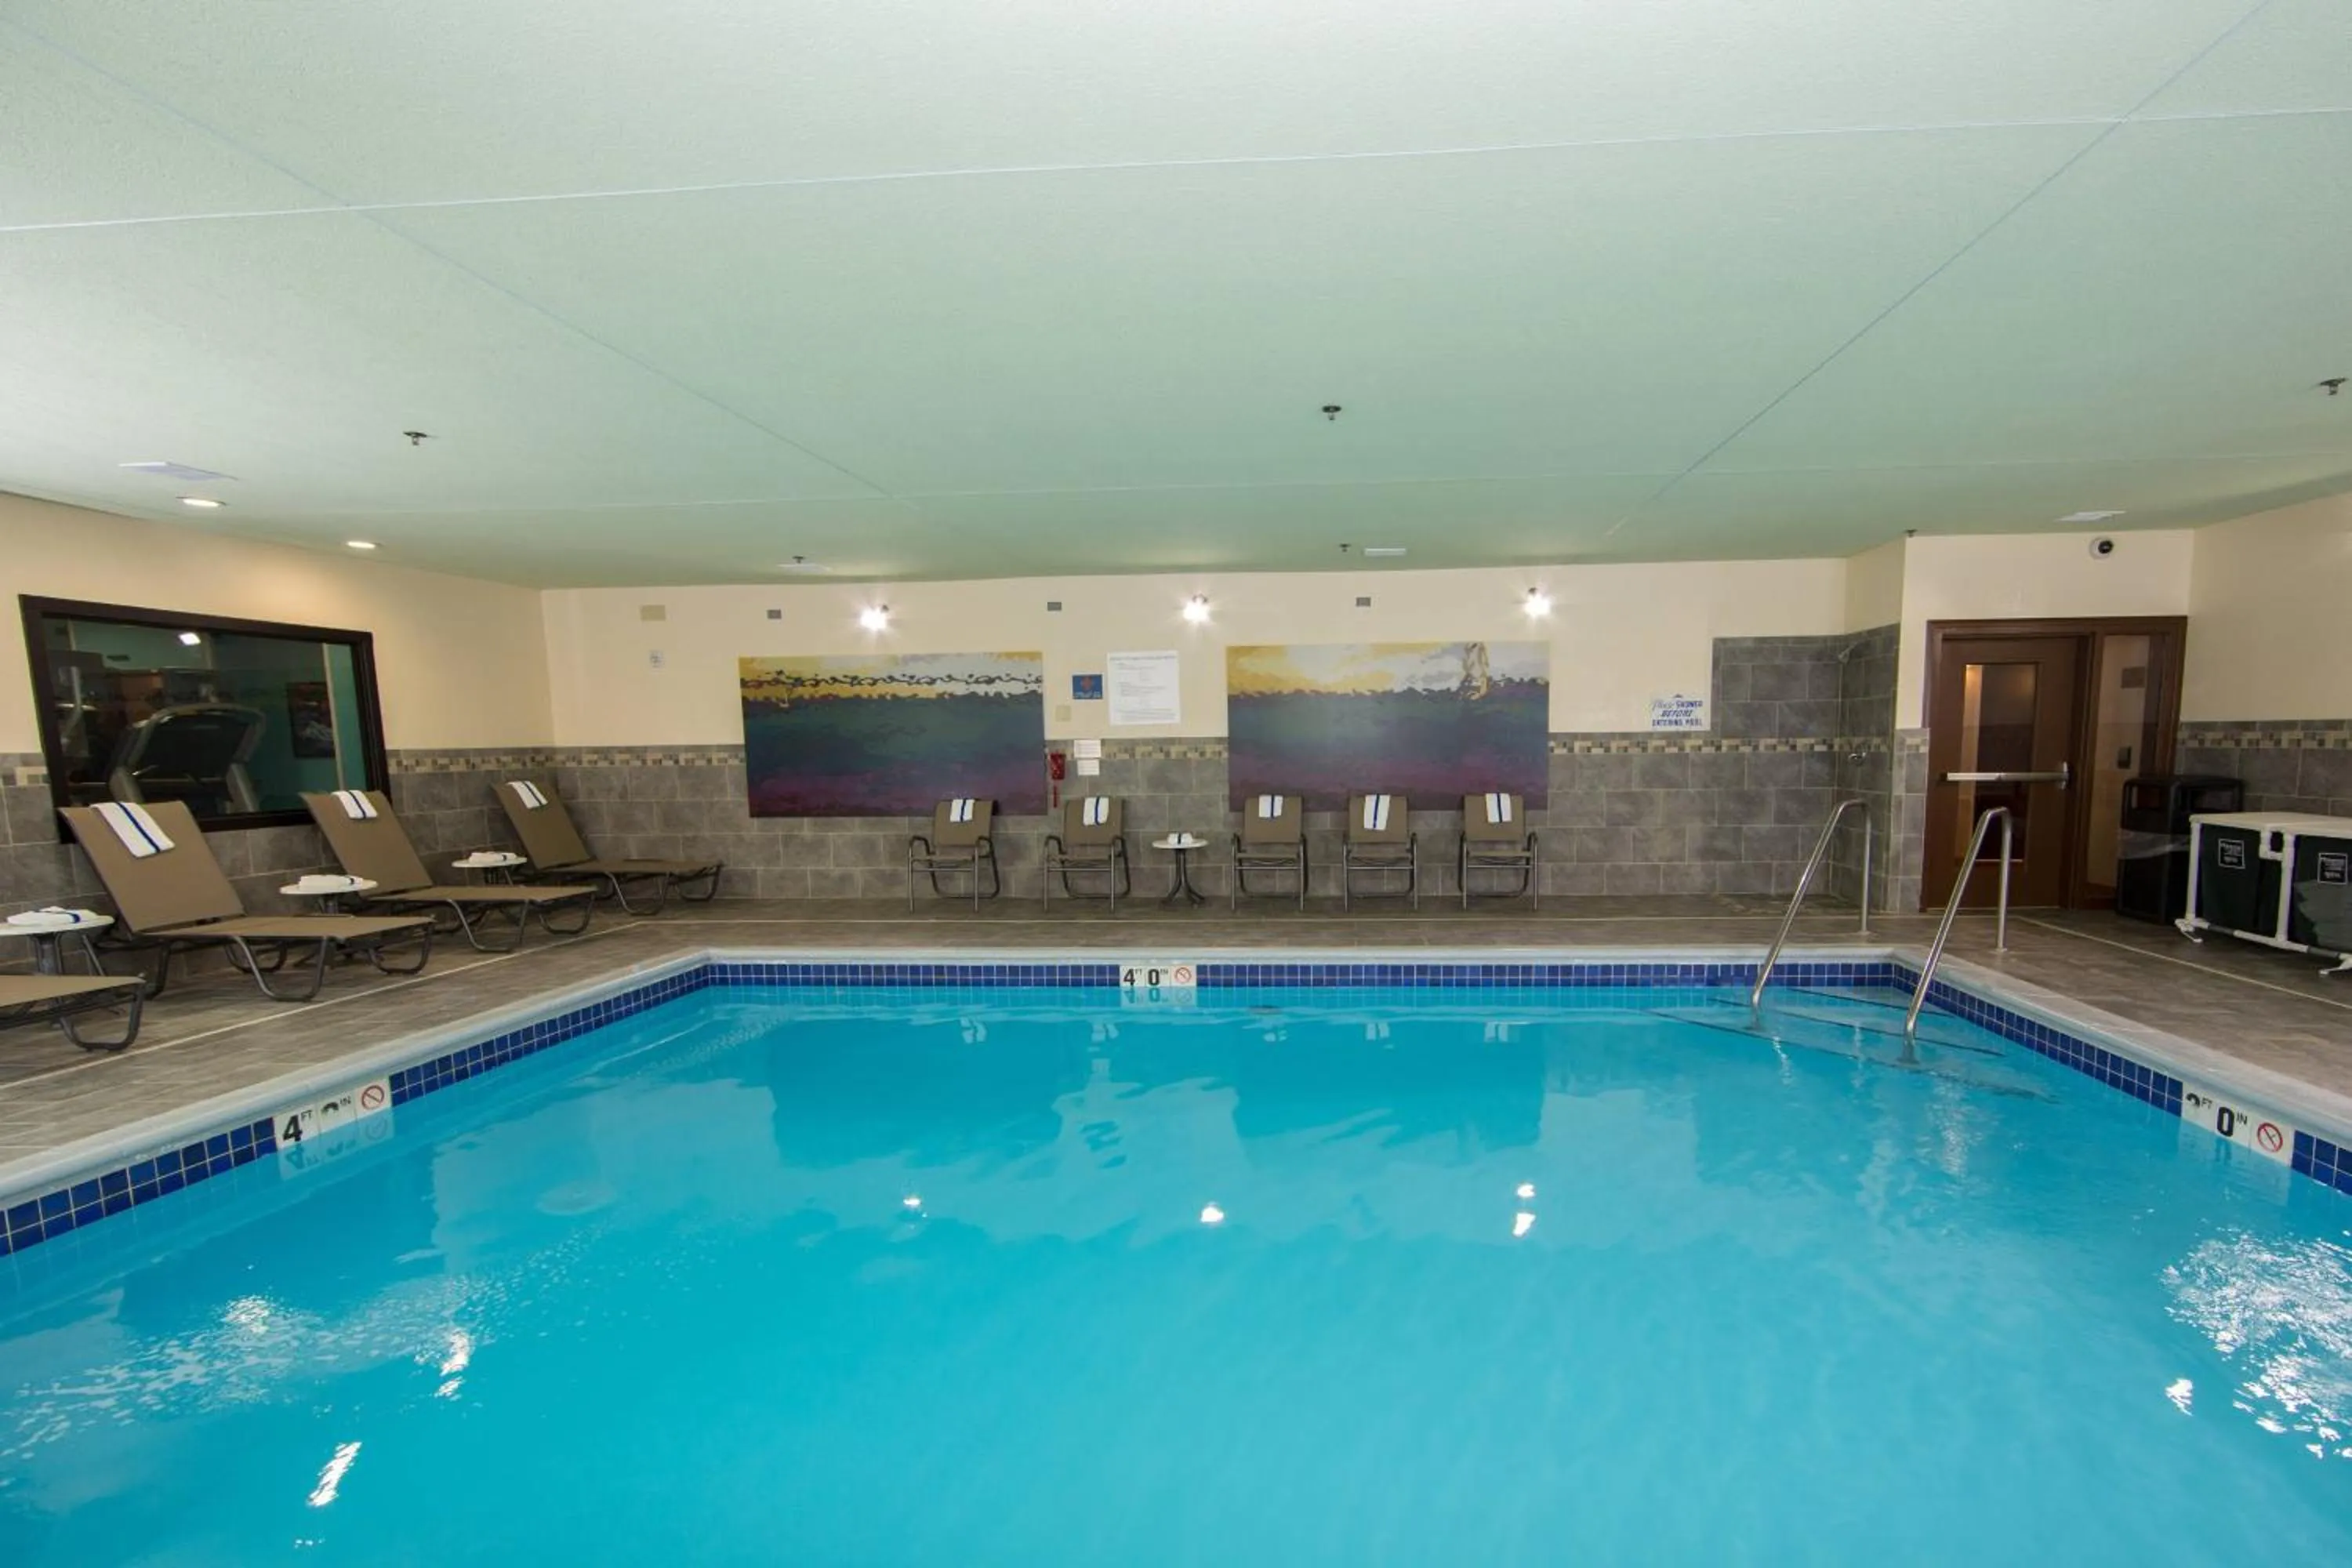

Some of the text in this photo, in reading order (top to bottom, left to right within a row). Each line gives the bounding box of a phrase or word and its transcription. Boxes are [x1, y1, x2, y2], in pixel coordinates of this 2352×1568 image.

[1123, 968, 1135, 985] 4
[1148, 968, 1160, 985] 0
[283, 1114, 303, 1142] 4
[300, 1109, 313, 1121] FT
[2200, 1098, 2212, 1109] FT
[2217, 1106, 2234, 1137] 0
[2236, 1111, 2248, 1125] IN
